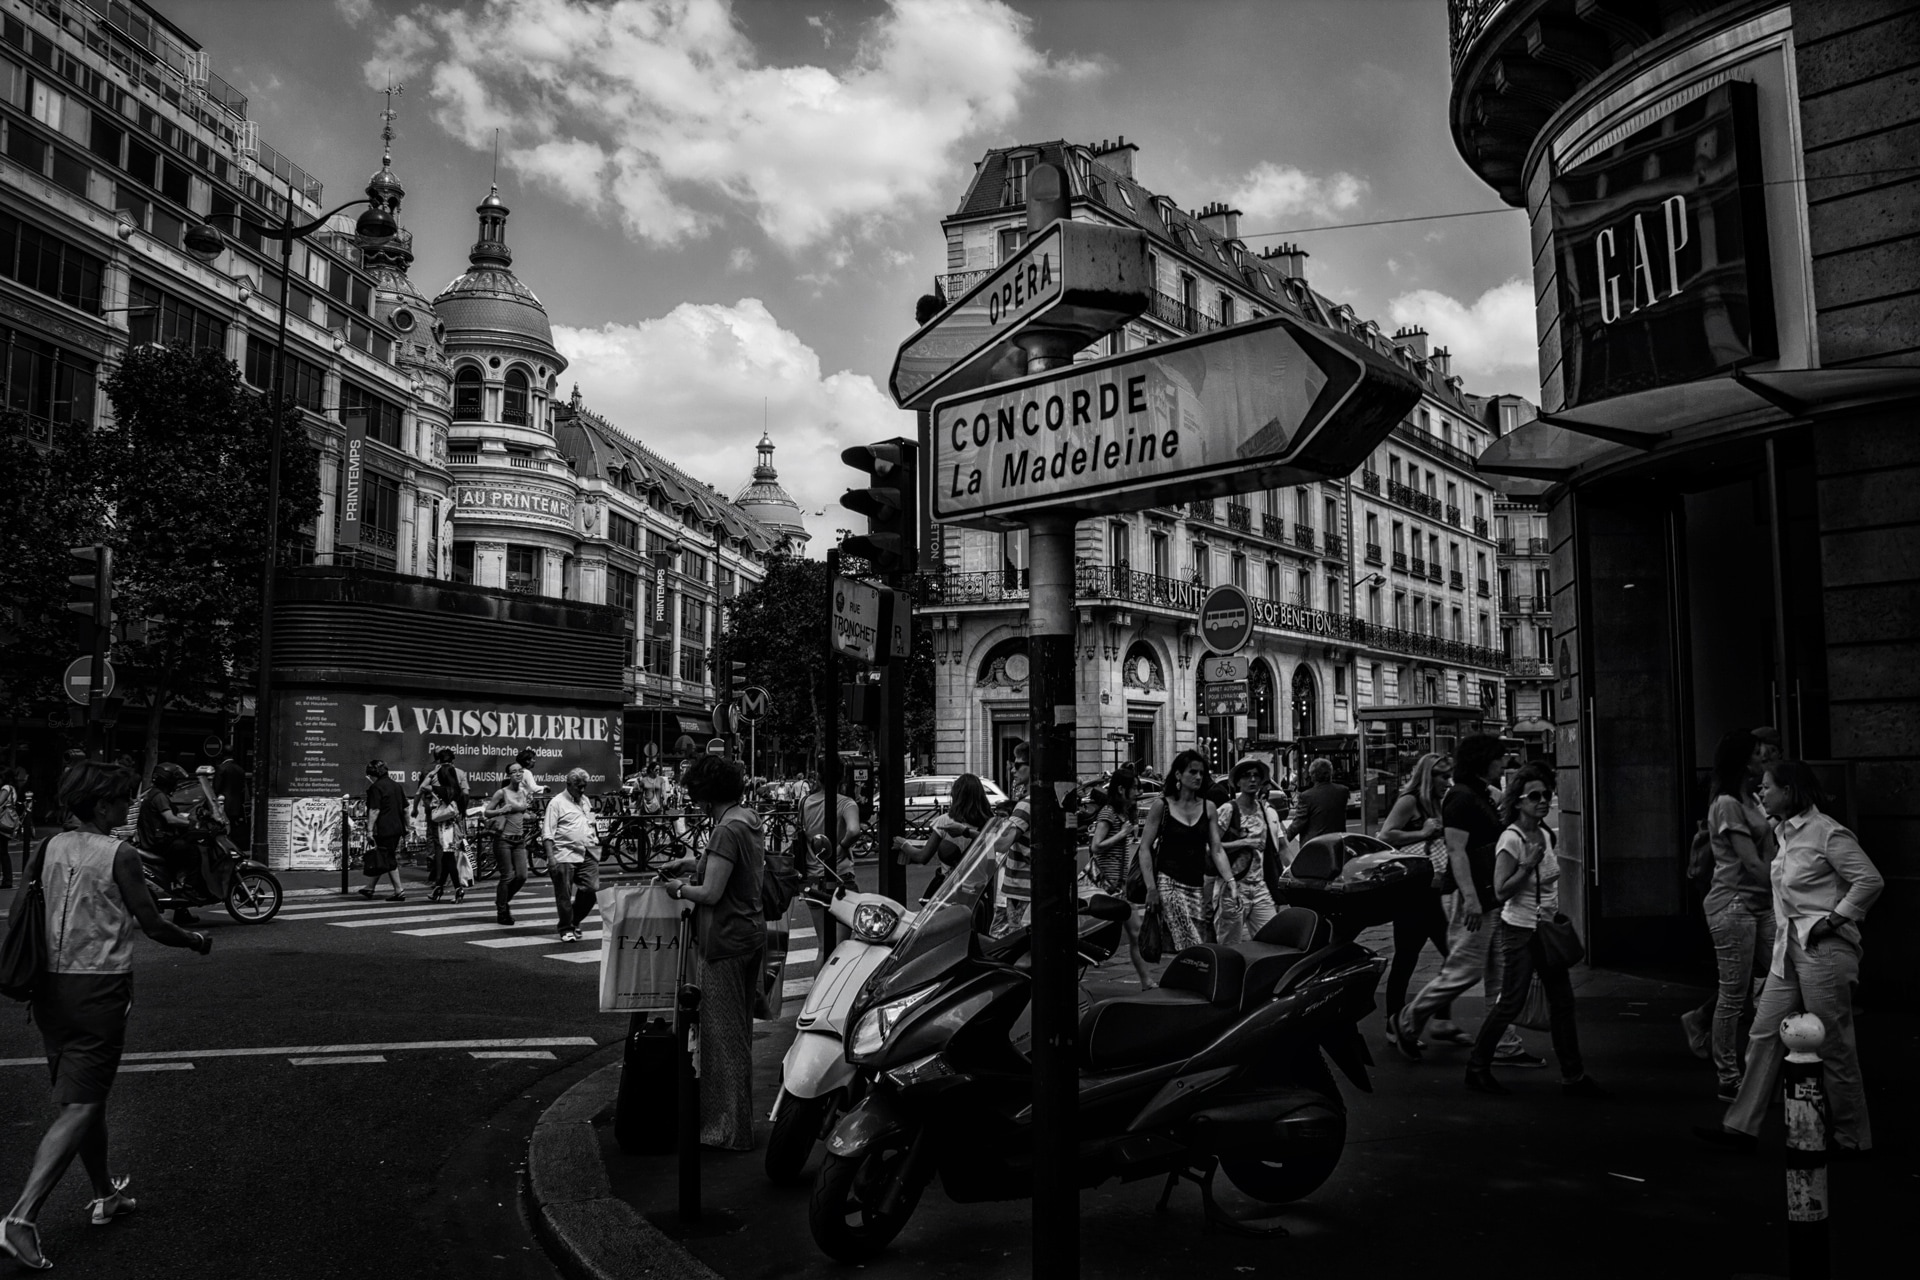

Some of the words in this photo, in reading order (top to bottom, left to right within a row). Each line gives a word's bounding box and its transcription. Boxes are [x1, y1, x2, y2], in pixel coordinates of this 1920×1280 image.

[1596, 194, 1688, 325] GAP
[990, 252, 1052, 325] OPÉRA
[951, 374, 1147, 451] CONCORDE
[345, 439, 361, 521] PRINTEMPS
[951, 464, 982, 498] La
[1001, 428, 1178, 488] Madeleine
[463, 491, 485, 505] AU
[491, 492, 570, 518] PRINTEMPS
[930, 520, 940, 561] ETTON.
[655, 569, 666, 622] PRINTEMPS
[849, 602, 861, 614] RUE
[1168, 580, 1212, 611] UNITE
[1264, 602, 1279, 623] OF
[1281, 606, 1331, 632] BENETTON
[833, 614, 876, 644] TRONCHET
[362, 704, 405, 734] LA
[411, 706, 609, 743] VAISSELLERIE
[482, 744, 519, 757] blanche
[469, 771, 508, 782] HAUSSM
